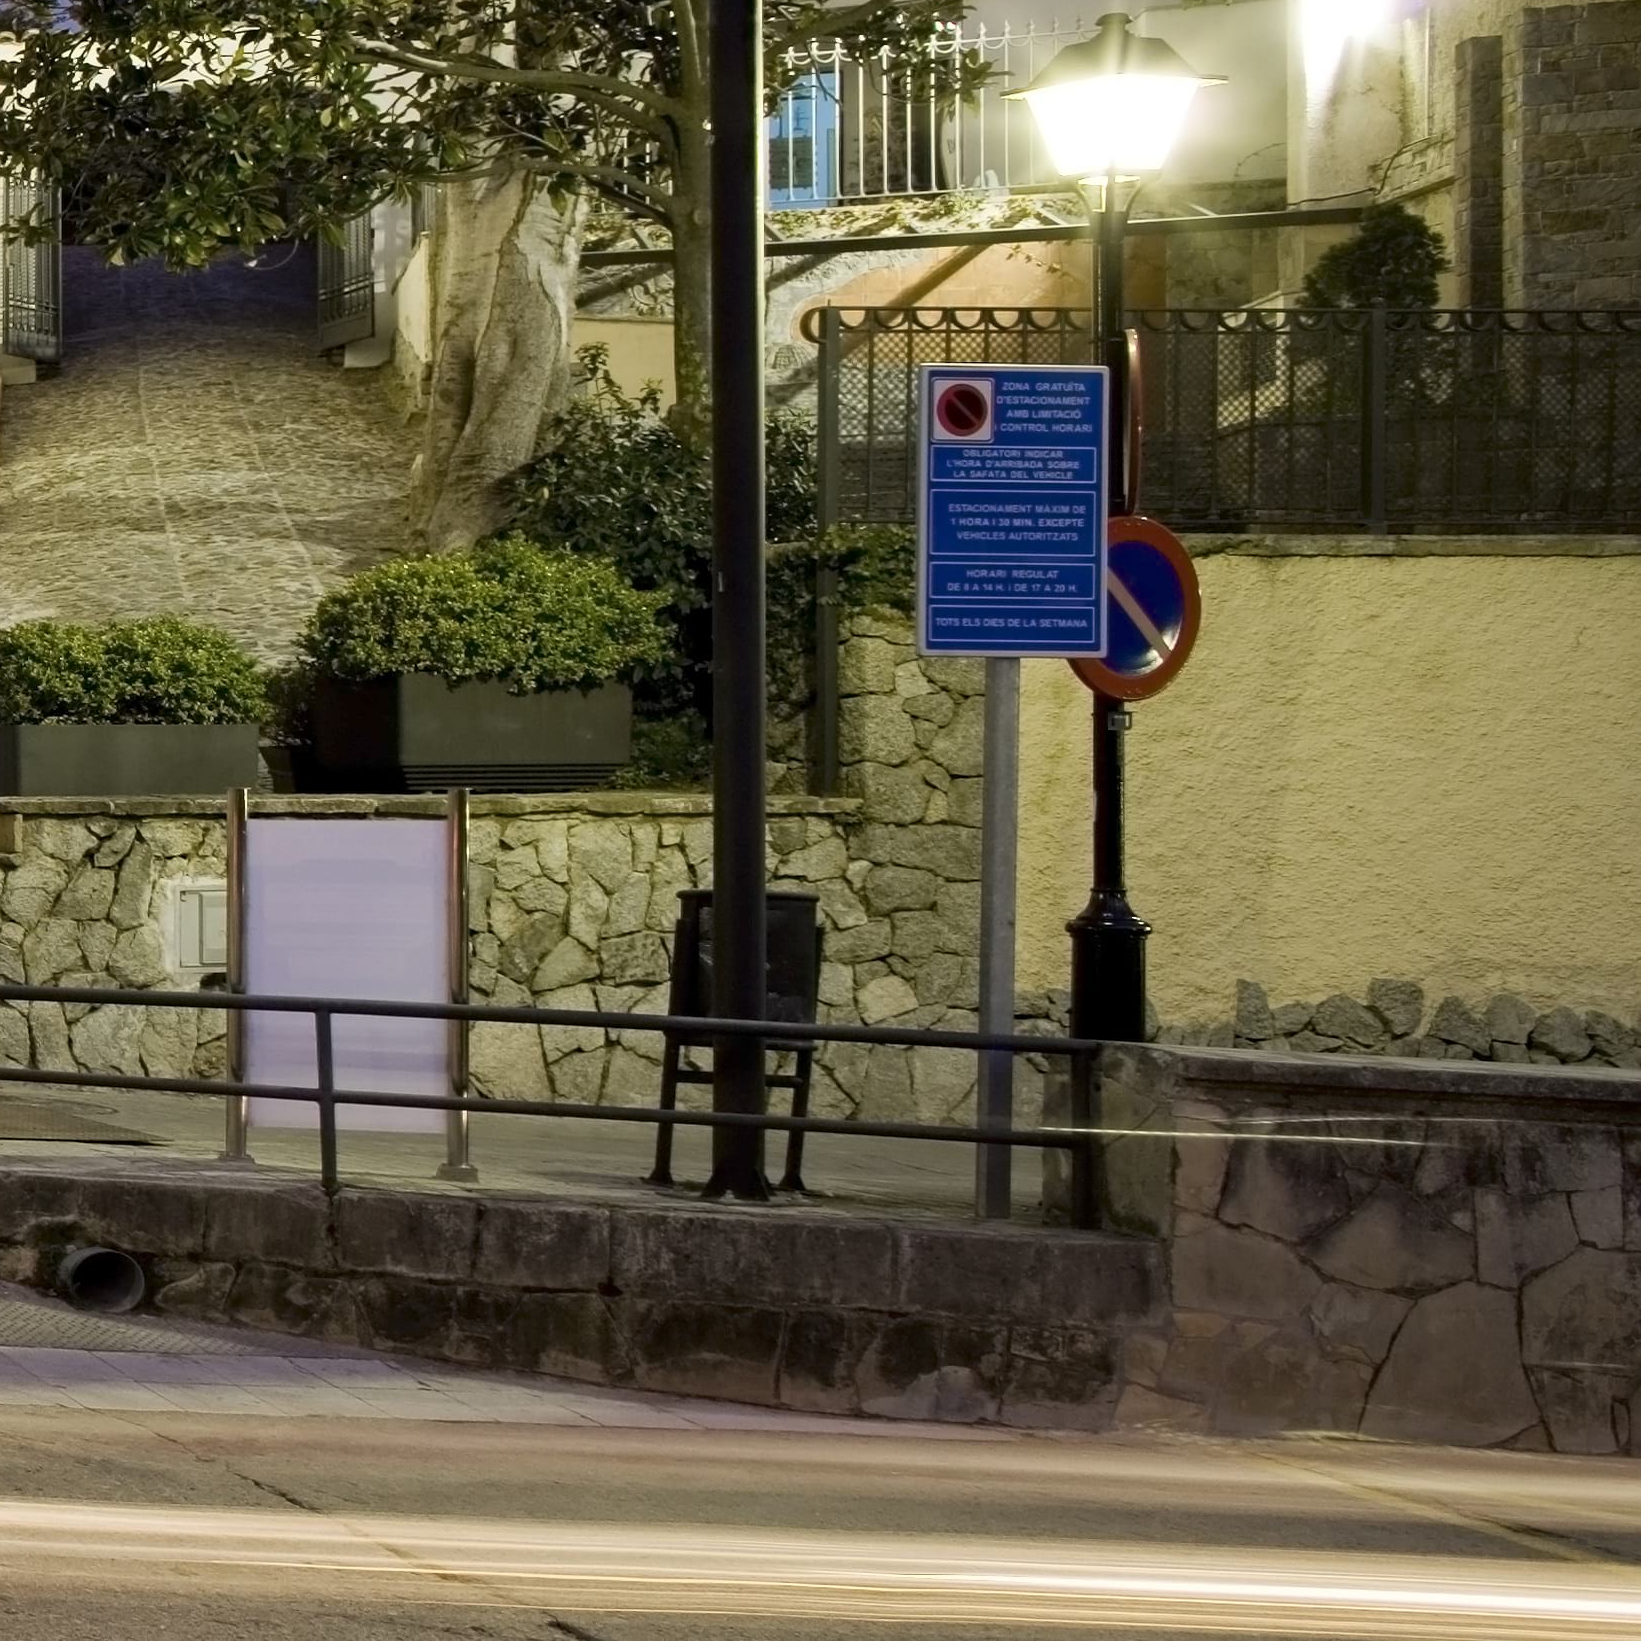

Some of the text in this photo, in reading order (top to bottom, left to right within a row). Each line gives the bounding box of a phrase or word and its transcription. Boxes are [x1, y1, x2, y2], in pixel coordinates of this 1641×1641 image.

[1002, 382, 1030, 391] ZONA
[996, 396, 1091, 405] D'ESTACIONAMENT
[1006, 409, 1082, 419] AMB LIMITACIÓ
[1000, 423, 1049, 432] CONTROL
[1052, 424, 1093, 433] HORARI
[962, 449, 1063, 458] OBLIGATORI INDICAR
[946, 460, 1080, 469] L'HORA D'ARRIBADA SOBRE
[953, 470, 1073, 479] LA SAFATA DEL VEHICLE
[948, 504, 1032, 513] ESTACIONAMENT
[1072, 505, 1086, 514] DE
[958, 518, 989, 526] HORA
[1012, 518, 1035, 527] MIN.
[1038, 519, 1085, 527] EXCEPTE
[956, 531, 1079, 541] VEHICLES AUTORITZATS
[966, 569, 1060, 579] HORARI REGULAT
[947, 583, 961, 591] DE
[972, 583, 980, 591] A
[1013, 584, 1027, 592] DE
[1044, 584, 1051, 592] A
[935, 617, 1087, 628] TOTS ELS DIES DE LA SETMANA
